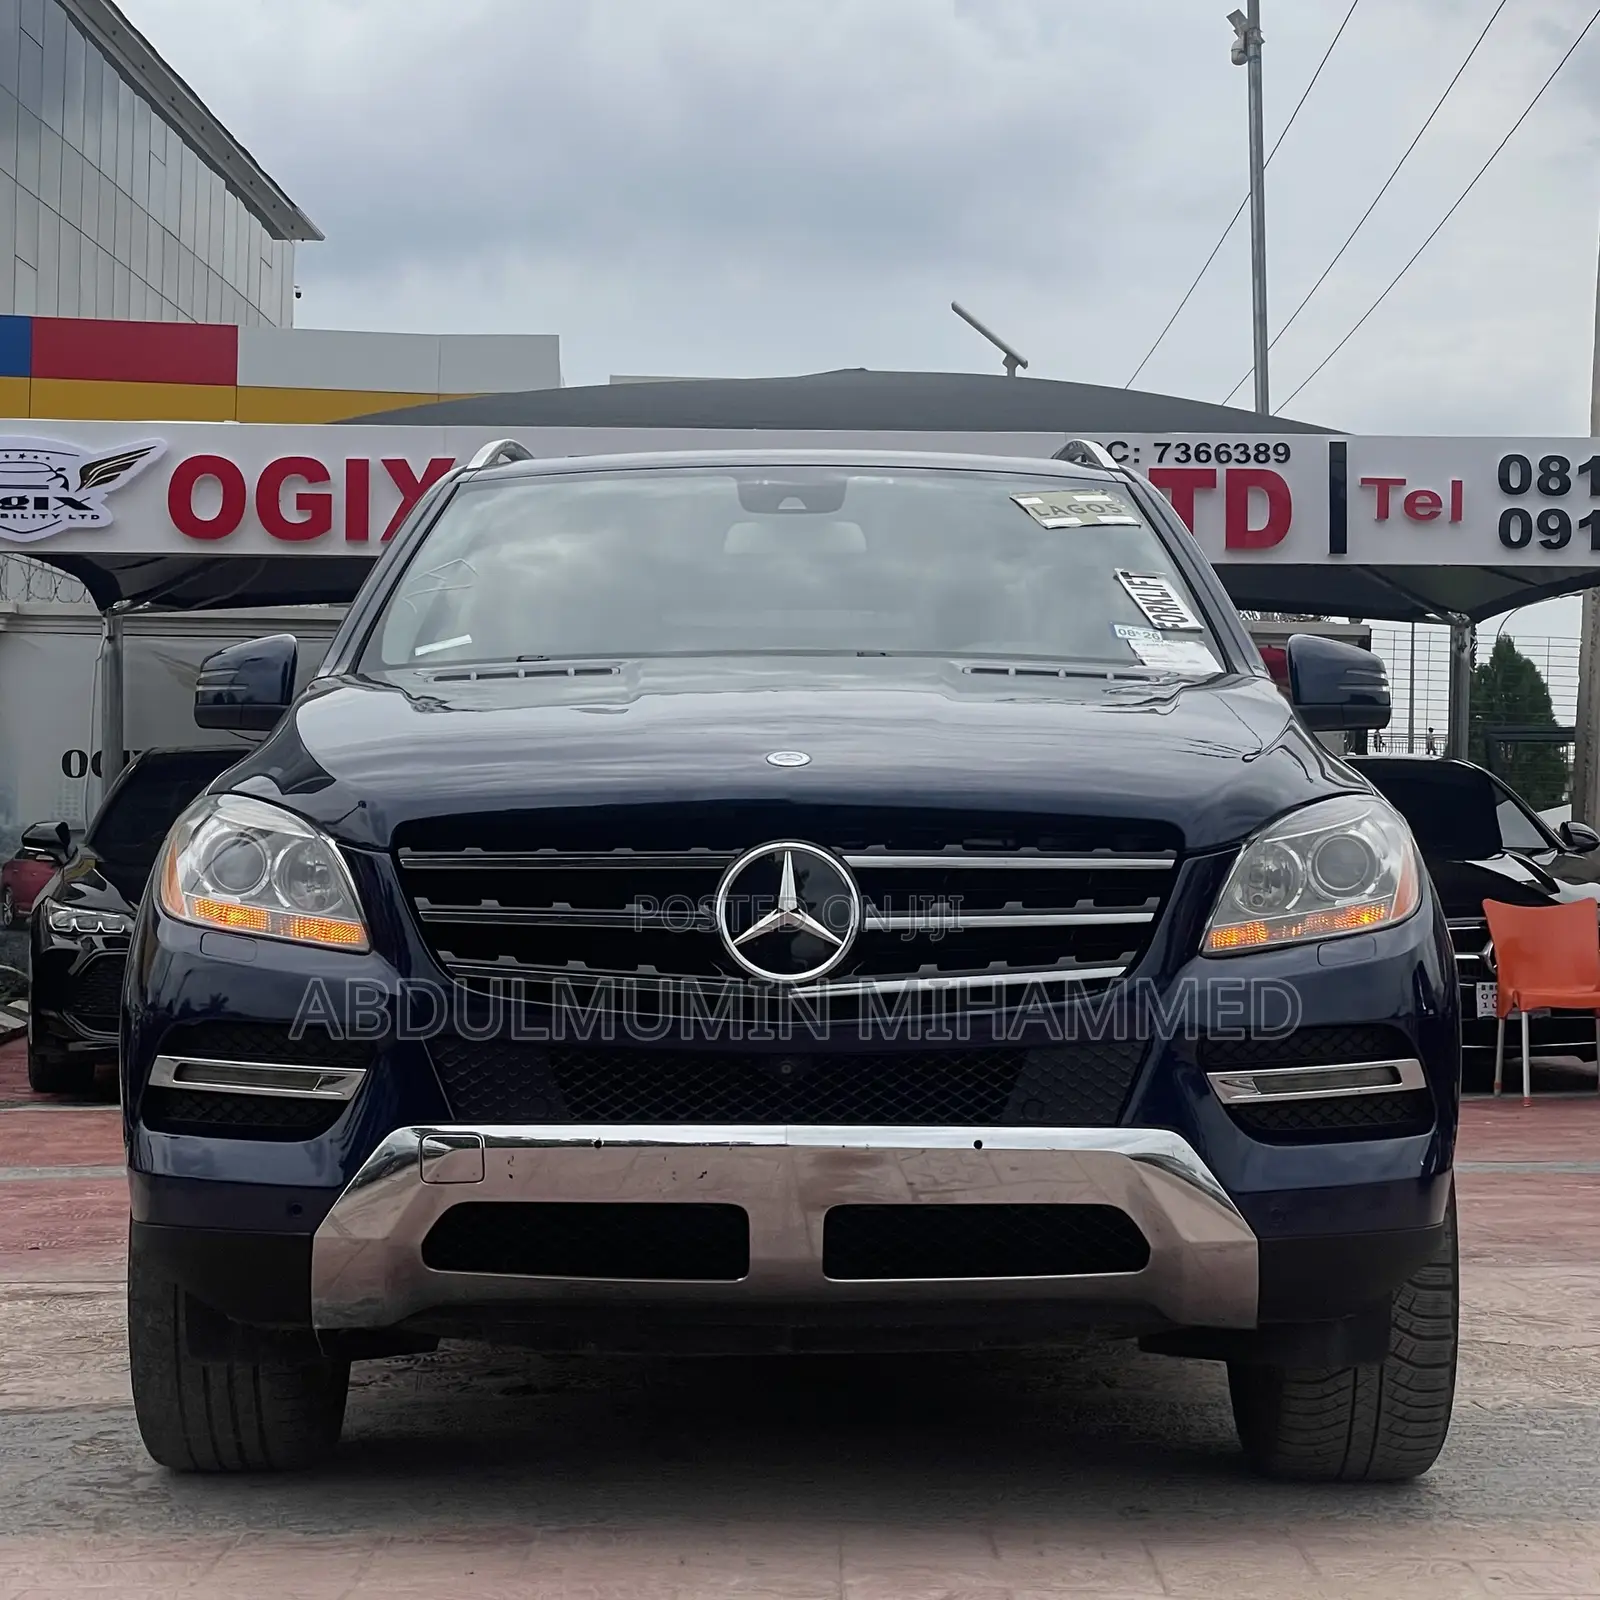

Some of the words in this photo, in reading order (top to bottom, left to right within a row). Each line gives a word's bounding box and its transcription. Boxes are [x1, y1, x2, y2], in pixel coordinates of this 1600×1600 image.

[1083, 440, 1140, 464] C:
[1153, 442, 1291, 464] 7366389
[1497, 453, 1600, 496] 081
[167, 454, 456, 541] OGIX
[1030, 502, 1123, 517] LAGOS
[1359, 477, 1463, 522] Tel
[1498, 507, 1600, 550] 091
